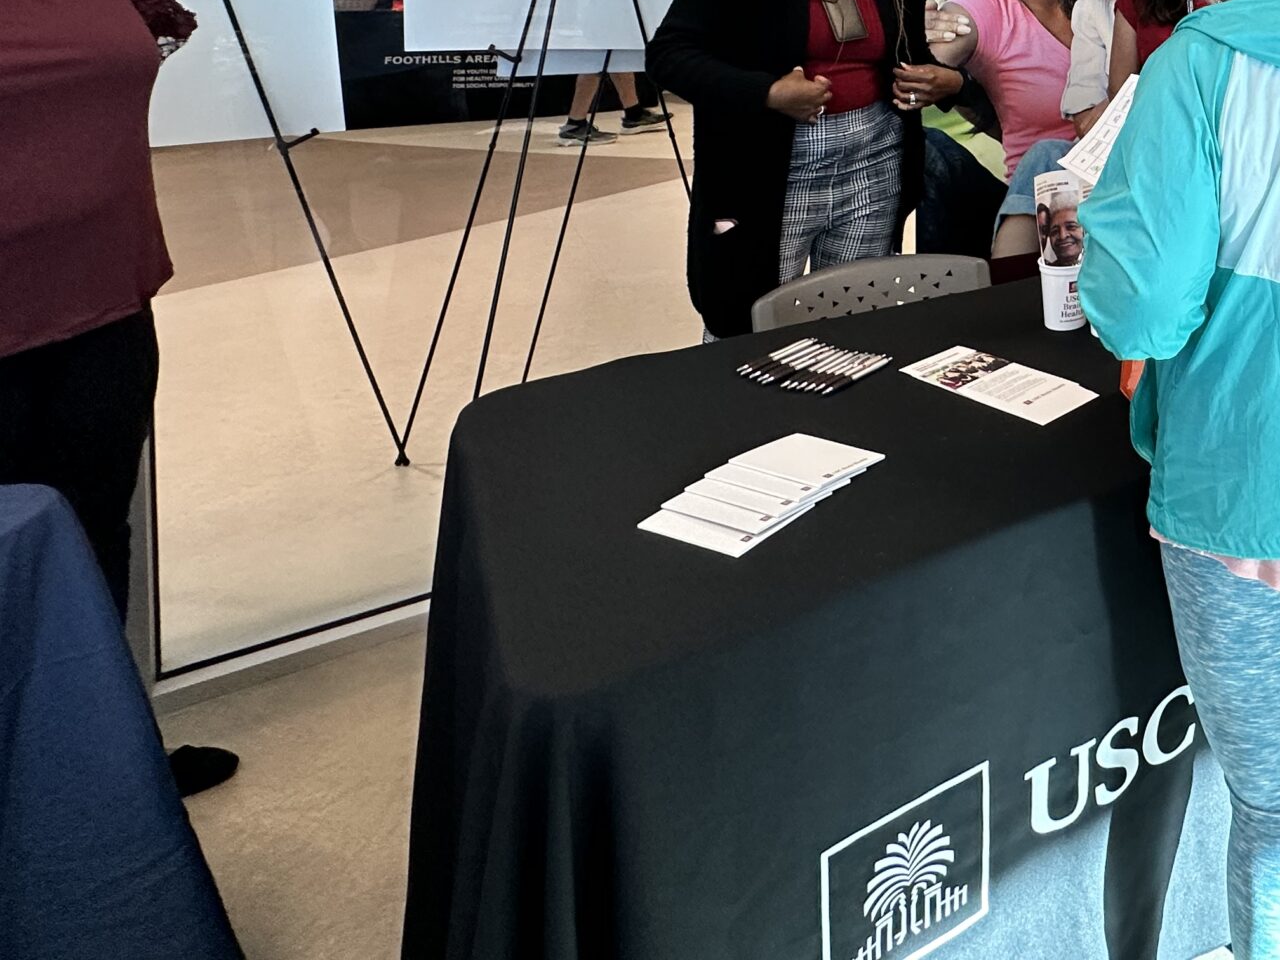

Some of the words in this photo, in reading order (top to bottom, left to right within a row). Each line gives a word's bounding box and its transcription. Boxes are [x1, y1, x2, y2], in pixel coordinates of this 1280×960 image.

[384, 54, 462, 64] FOOTHILLS
[465, 54, 499, 63] AREA
[1063, 302, 1081, 311] Brai
[1023, 684, 1198, 835] USC
